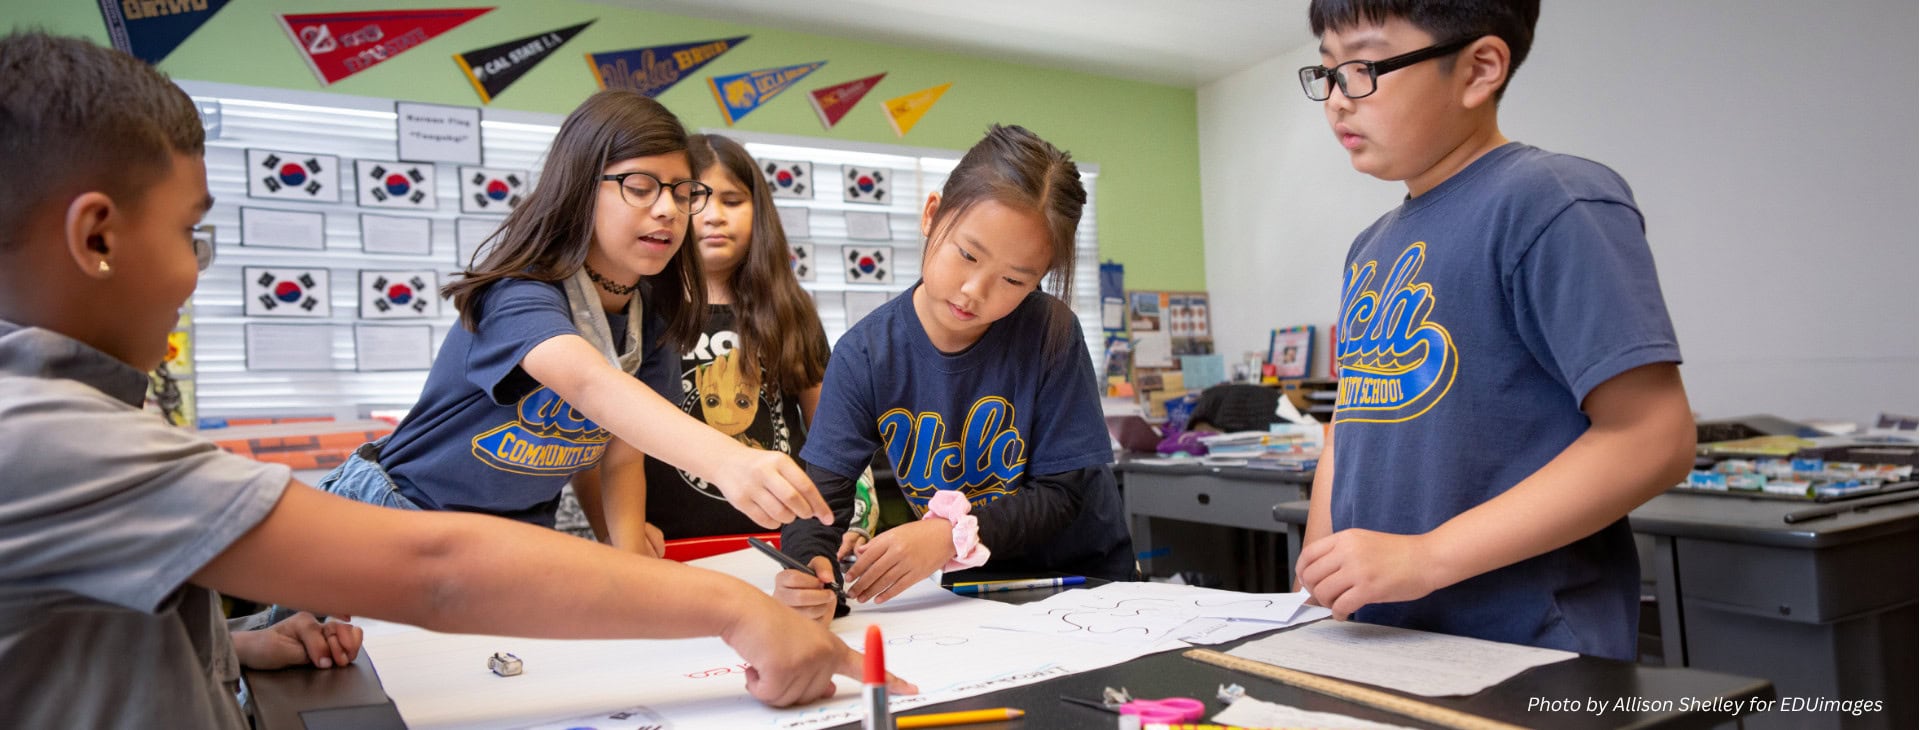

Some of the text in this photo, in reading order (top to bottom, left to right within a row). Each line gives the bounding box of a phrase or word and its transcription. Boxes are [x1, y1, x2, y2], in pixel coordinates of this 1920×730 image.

[484, 57, 512, 75] CAL
[508, 39, 545, 64] STATE
[1360, 377, 1404, 404] SCHOOL
[497, 431, 581, 468] COMMUNITY
